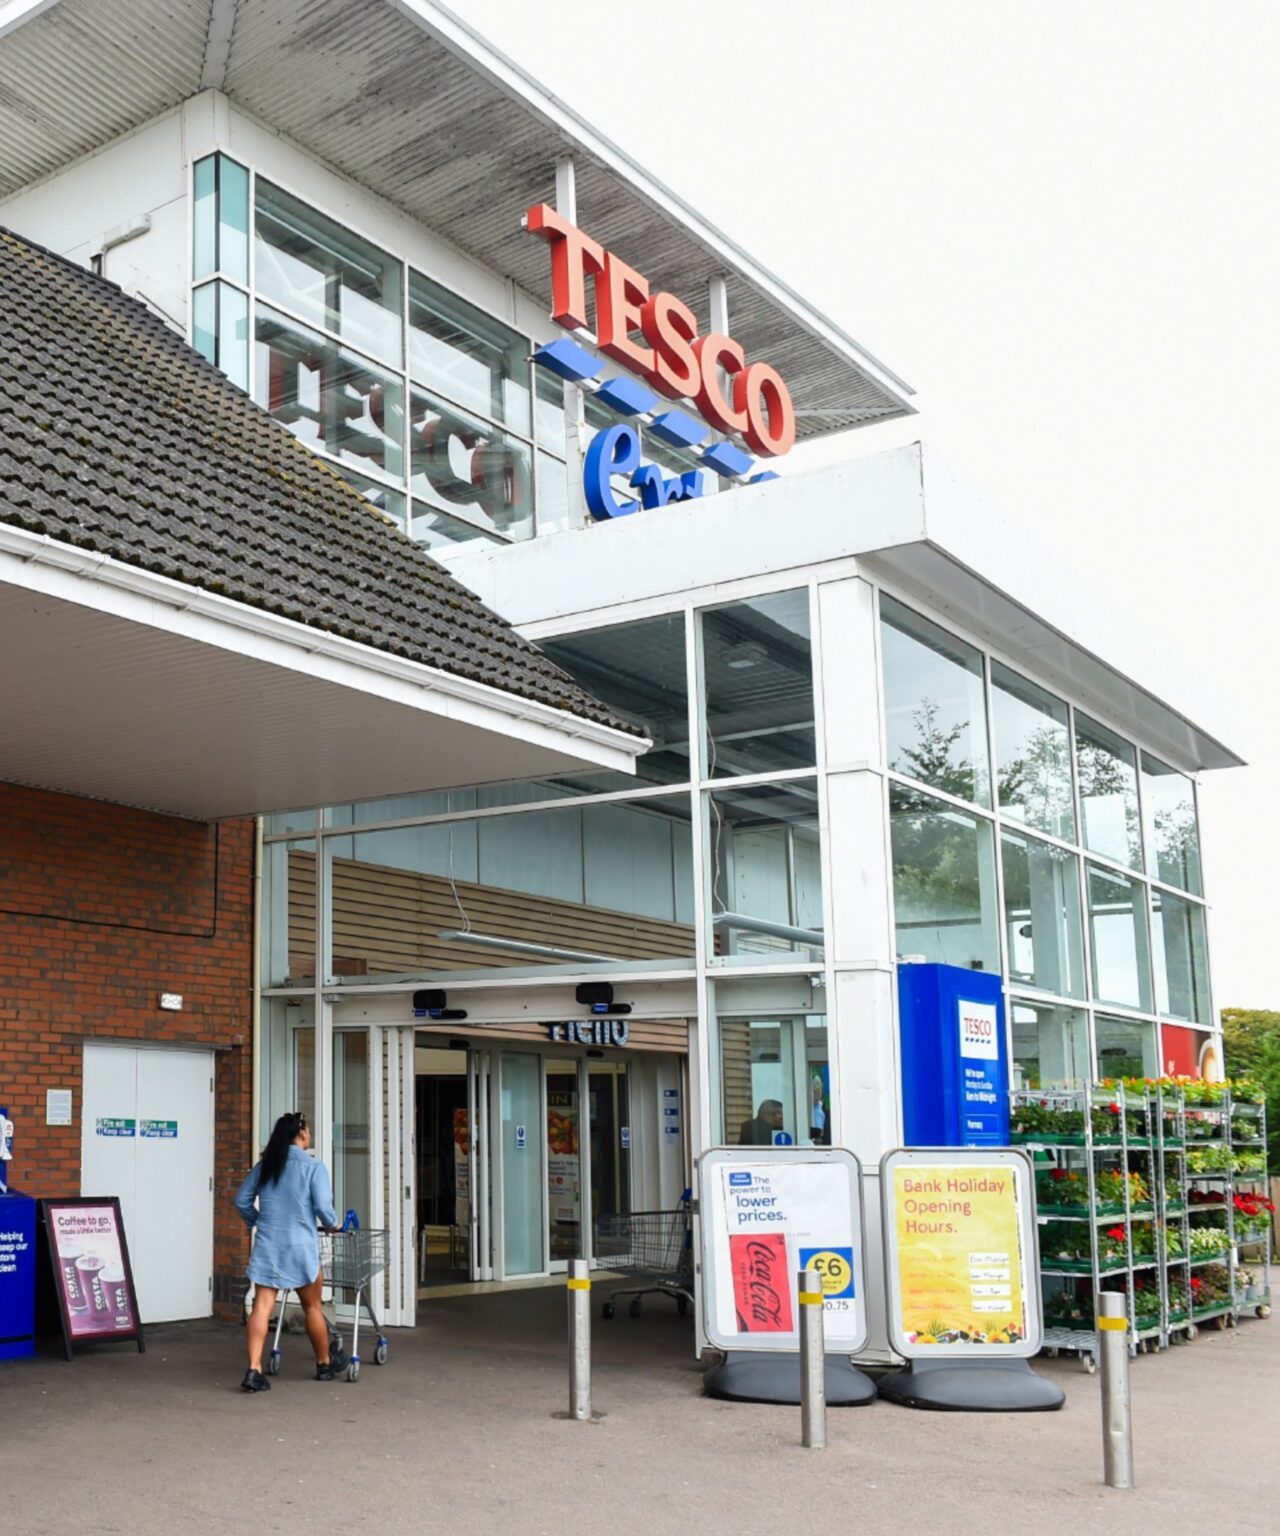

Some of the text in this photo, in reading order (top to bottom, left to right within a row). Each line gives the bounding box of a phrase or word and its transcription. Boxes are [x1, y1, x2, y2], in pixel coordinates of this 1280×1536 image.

[526, 202, 795, 459] TESCO
[963, 1017, 992, 1037] TESCO
[753, 1176, 770, 1184] The
[904, 1178, 1005, 1195] Bank Holiday
[730, 1187, 759, 1196] power
[736, 1195, 778, 1207] lower
[904, 1199, 971, 1216] Opening
[58, 1215, 87, 1226] Coffee
[88, 1216, 97, 1225] to
[738, 1209, 787, 1225] prices.
[906, 1219, 958, 1233] Hours.
[814, 1258, 842, 1277] £6
